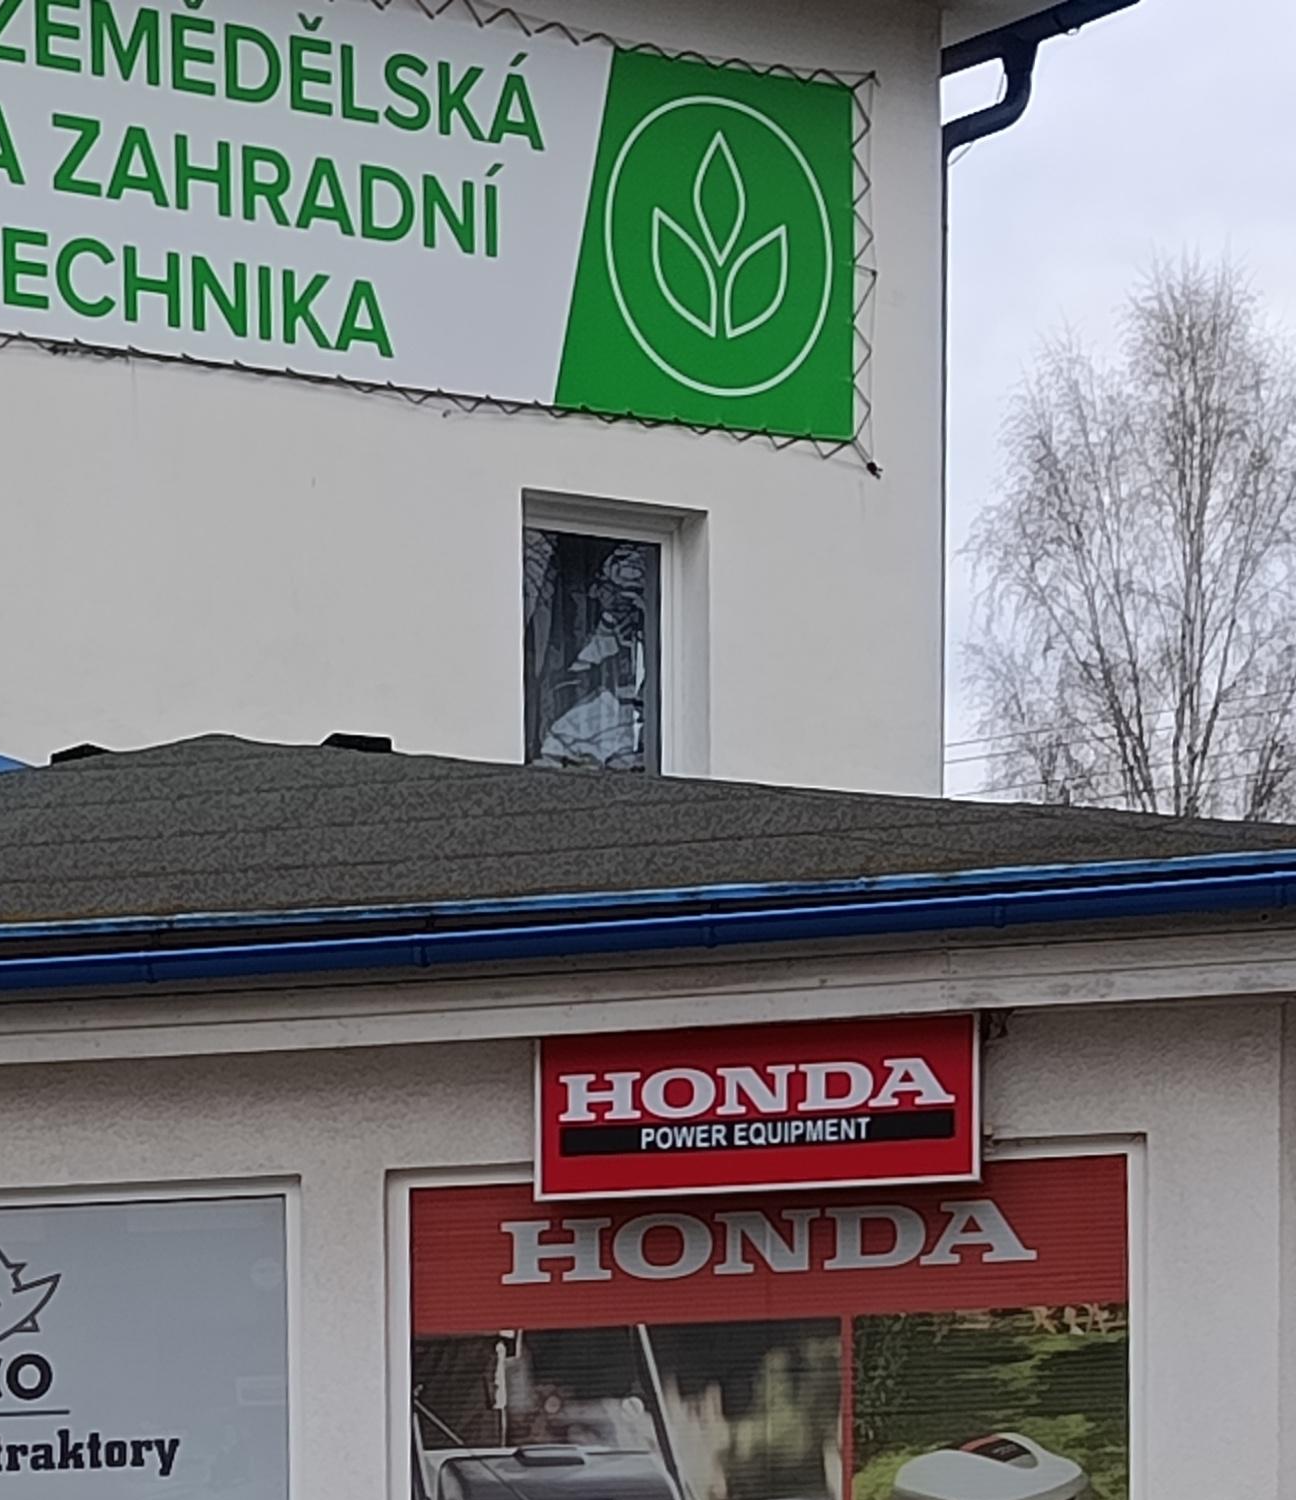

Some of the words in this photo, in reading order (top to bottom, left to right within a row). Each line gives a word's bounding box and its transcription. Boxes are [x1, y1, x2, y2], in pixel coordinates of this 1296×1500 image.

[52, 113, 505, 258] ZAHRADNÍ
[558, 1056, 956, 1123] HONDA
[640, 1124, 728, 1151] POWER
[733, 1116, 871, 1146] EQUIPMENT
[500, 1199, 1038, 1285] HONDA
